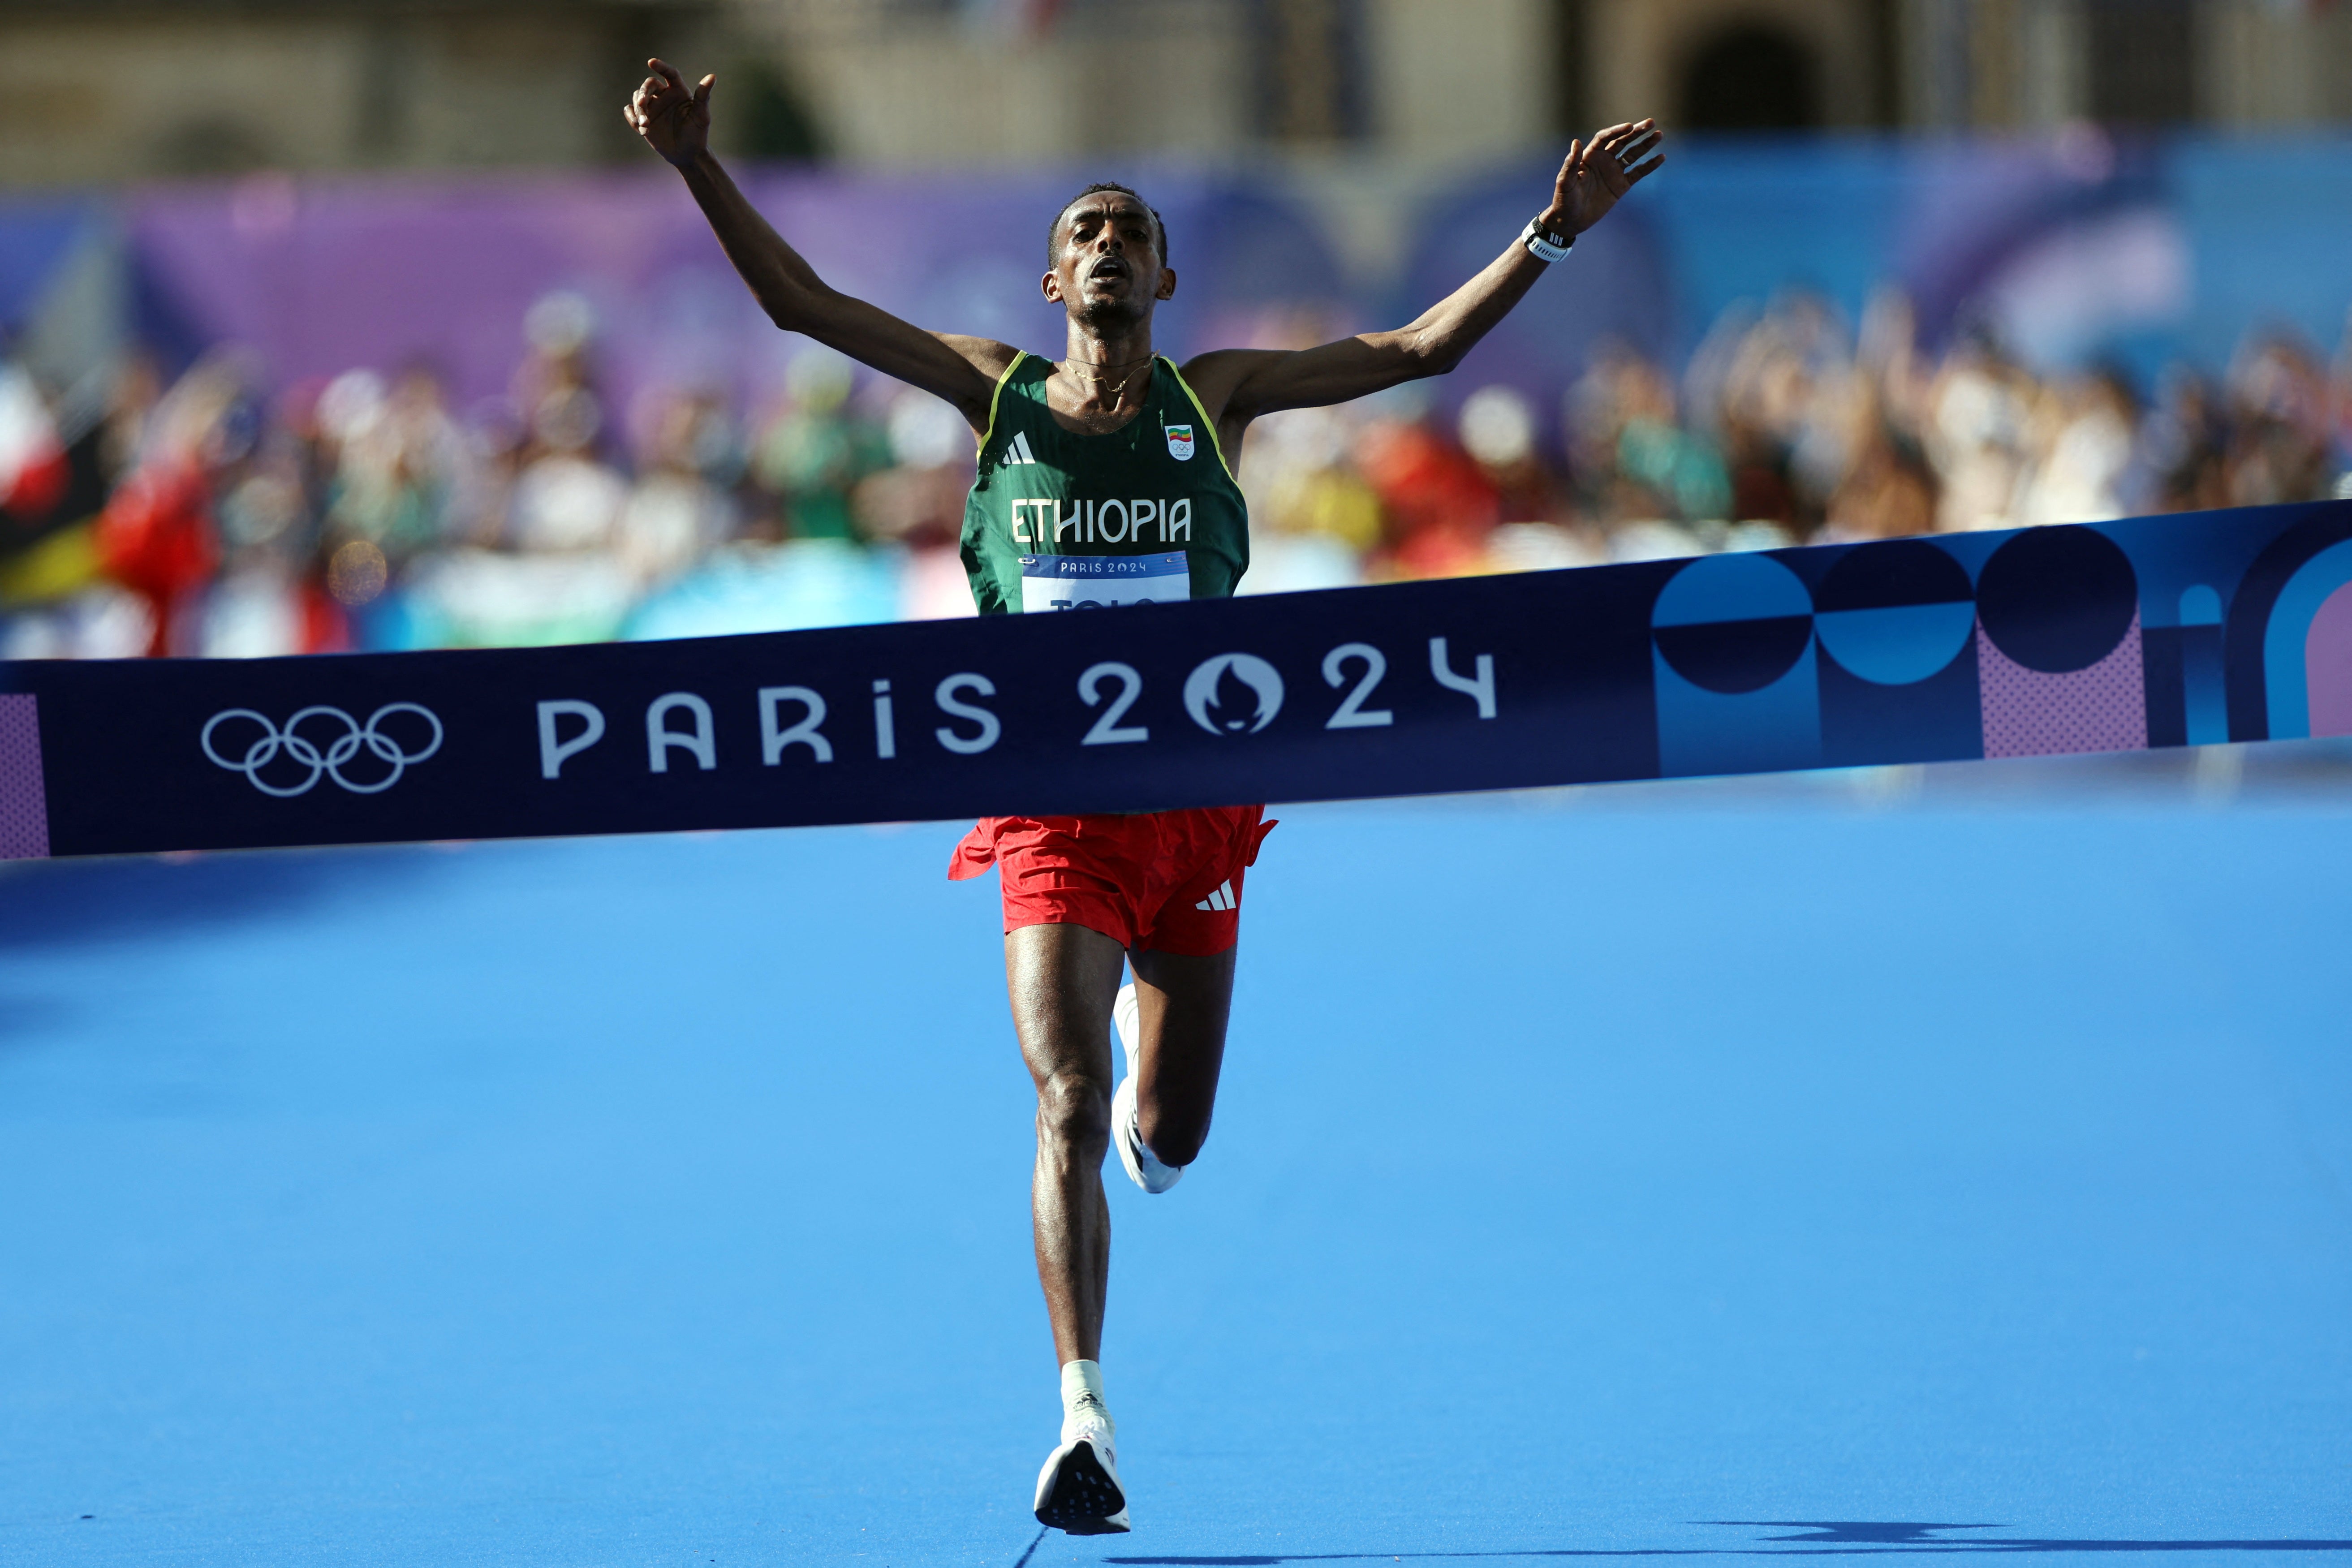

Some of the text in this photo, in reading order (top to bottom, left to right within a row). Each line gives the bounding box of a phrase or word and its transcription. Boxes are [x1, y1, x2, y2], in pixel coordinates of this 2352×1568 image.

[1011, 498, 1191, 543] ETHIOPIA
[1107, 562, 1146, 573] 2024
[1078, 637, 1497, 745] 2024
